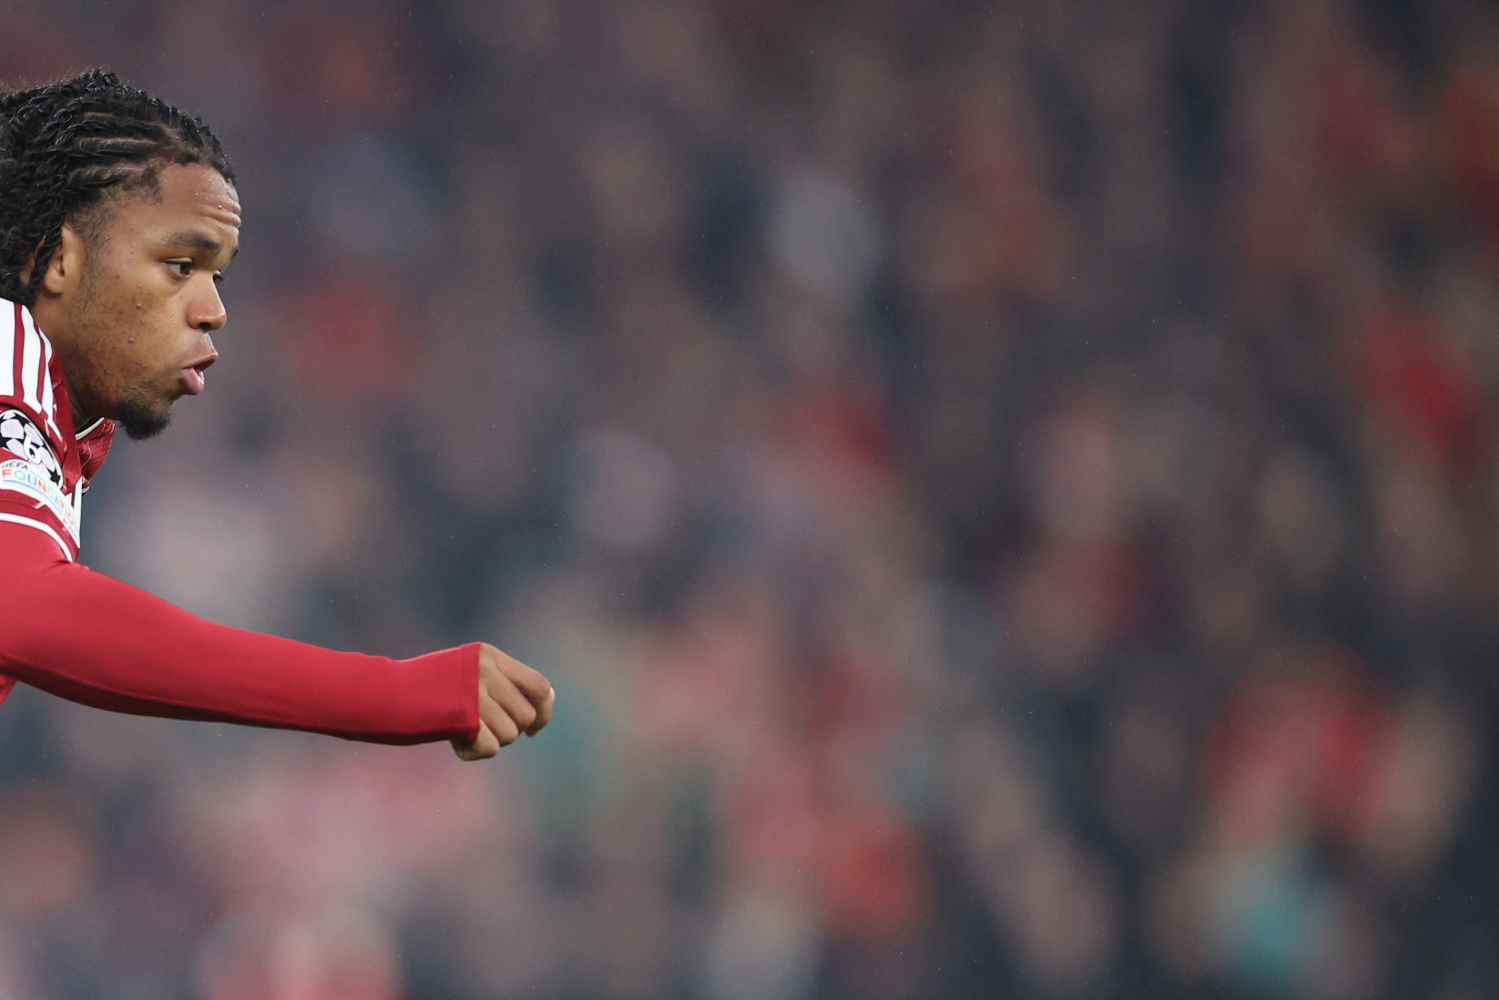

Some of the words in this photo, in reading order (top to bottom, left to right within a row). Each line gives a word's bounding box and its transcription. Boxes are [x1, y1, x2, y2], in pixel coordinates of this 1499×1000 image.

[23, 435, 42, 465] 6
[2, 461, 28, 470] UEFA
[2, 468, 77, 528] FOUNDATIO
